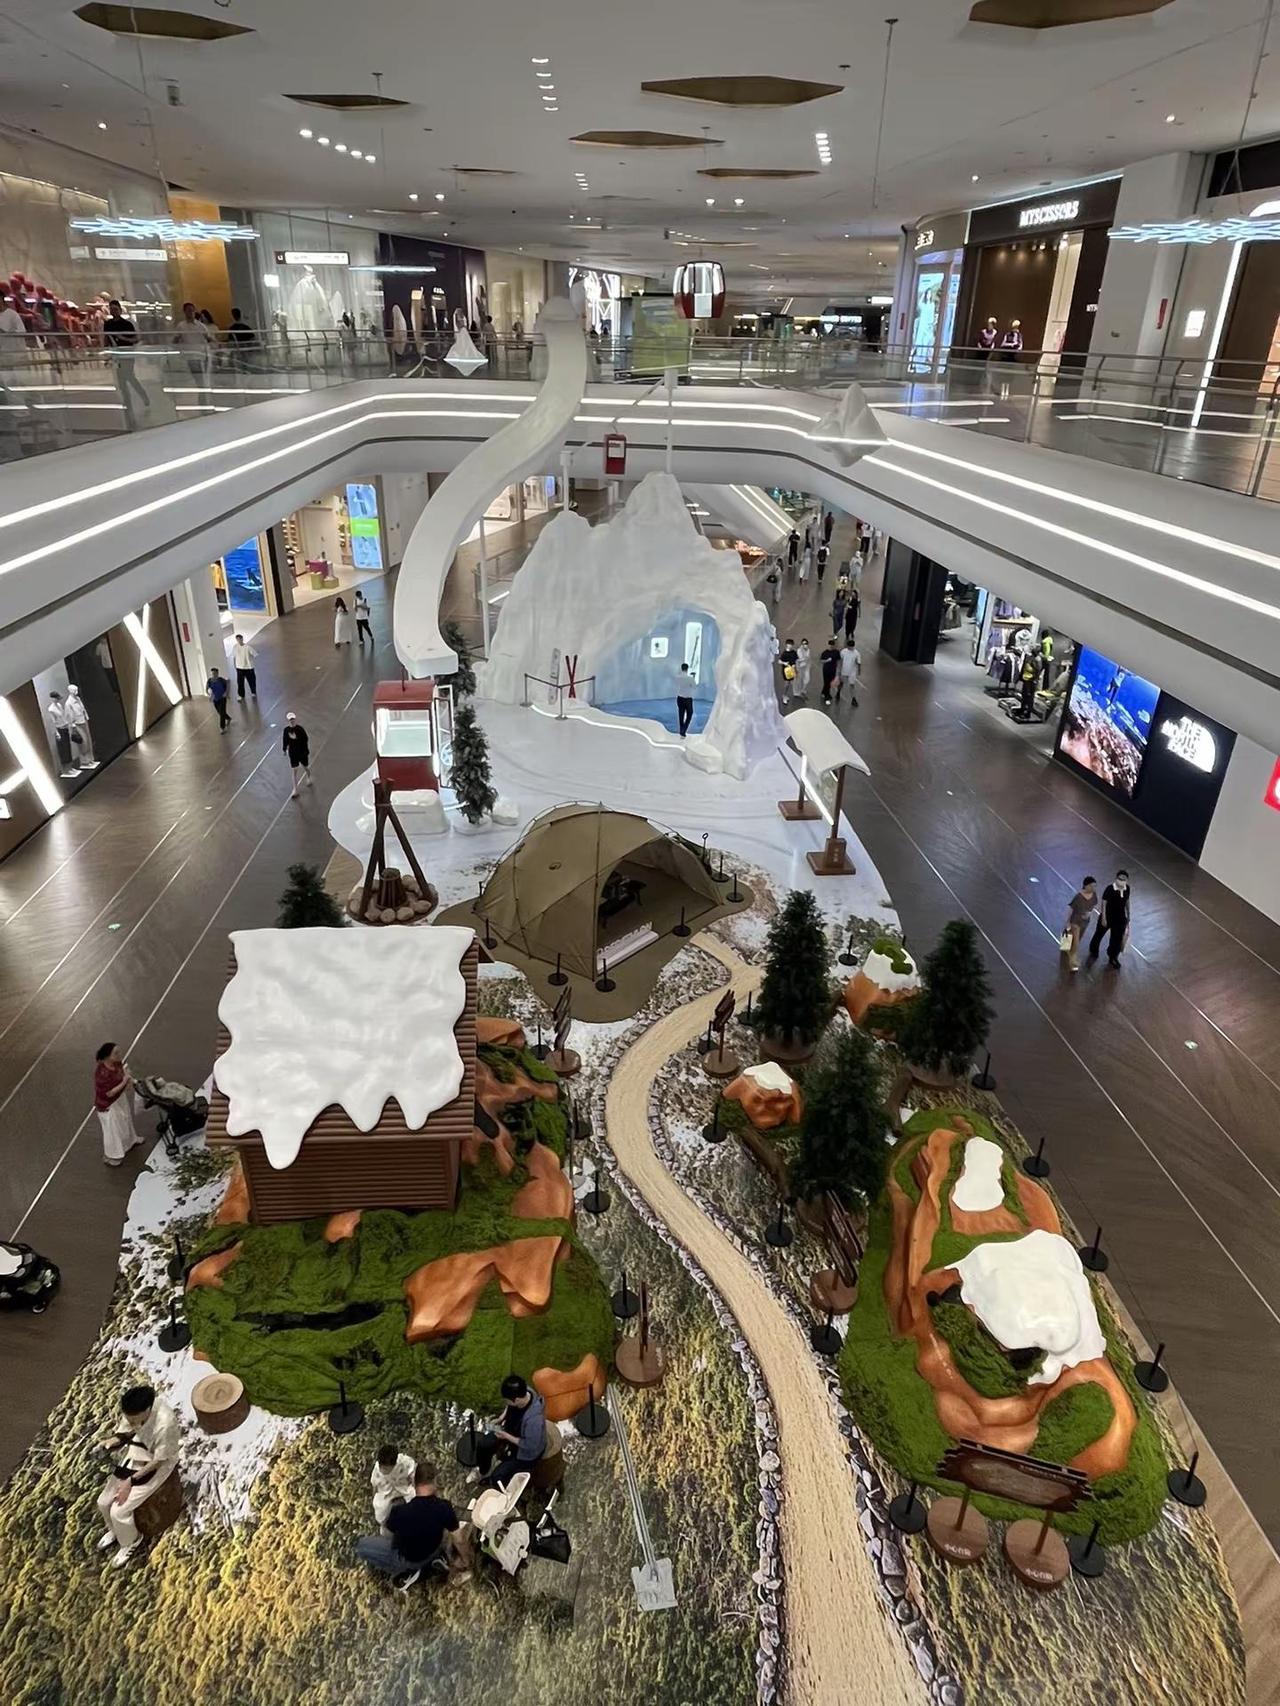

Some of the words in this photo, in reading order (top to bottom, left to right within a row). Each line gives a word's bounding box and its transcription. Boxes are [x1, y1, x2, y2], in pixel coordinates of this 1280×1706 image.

[1161, 719, 1200, 750] NORTH
[1180, 716, 1202, 736] THE
[1168, 739, 1194, 759] FACE
